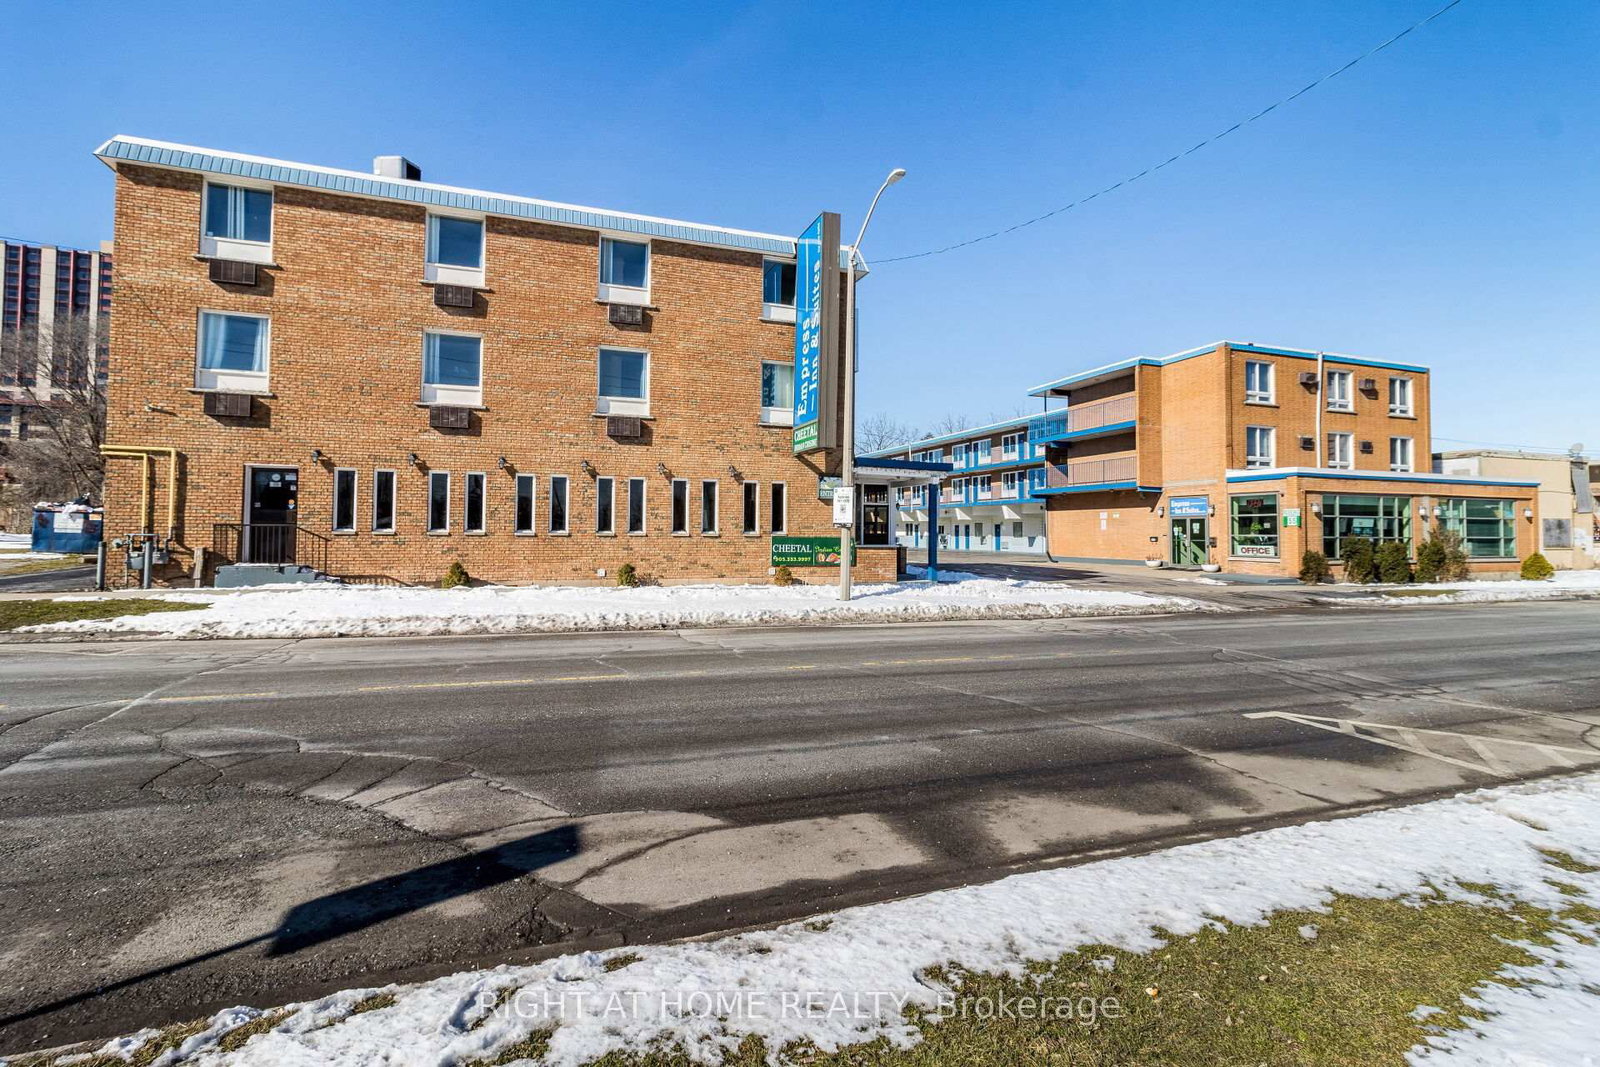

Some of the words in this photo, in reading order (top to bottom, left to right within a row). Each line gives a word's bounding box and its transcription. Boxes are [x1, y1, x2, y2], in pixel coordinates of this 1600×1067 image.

[811, 259, 821, 329] Suites
[810, 332, 819, 348] &
[797, 317, 811, 417] Empress
[809, 355, 818, 391] Inn
[772, 544, 812, 553] CHEETAL
